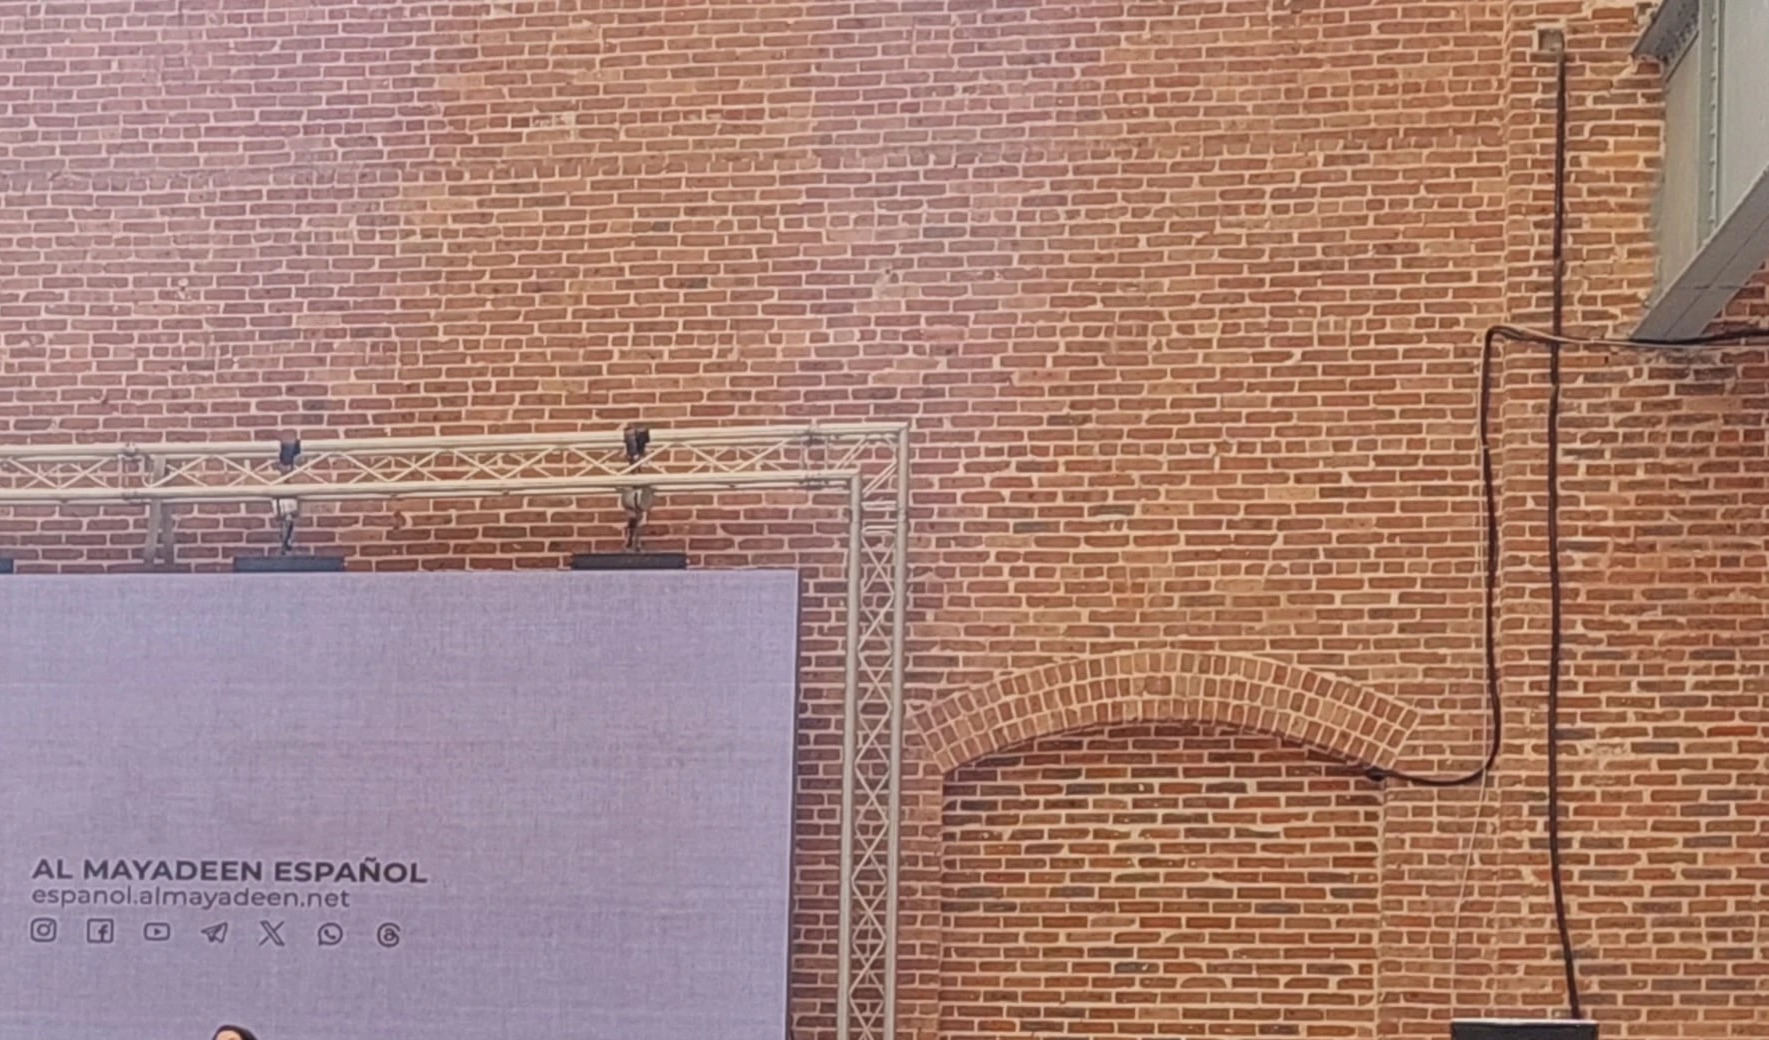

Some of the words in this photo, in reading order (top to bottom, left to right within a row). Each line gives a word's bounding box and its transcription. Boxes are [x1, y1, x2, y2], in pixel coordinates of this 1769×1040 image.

[31, 858, 74, 880] AL
[82, 858, 263, 882] MAYADEEN
[274, 856, 429, 884] ESPAÑOL
[31, 884, 351, 911] espanol.almayadeen.net
